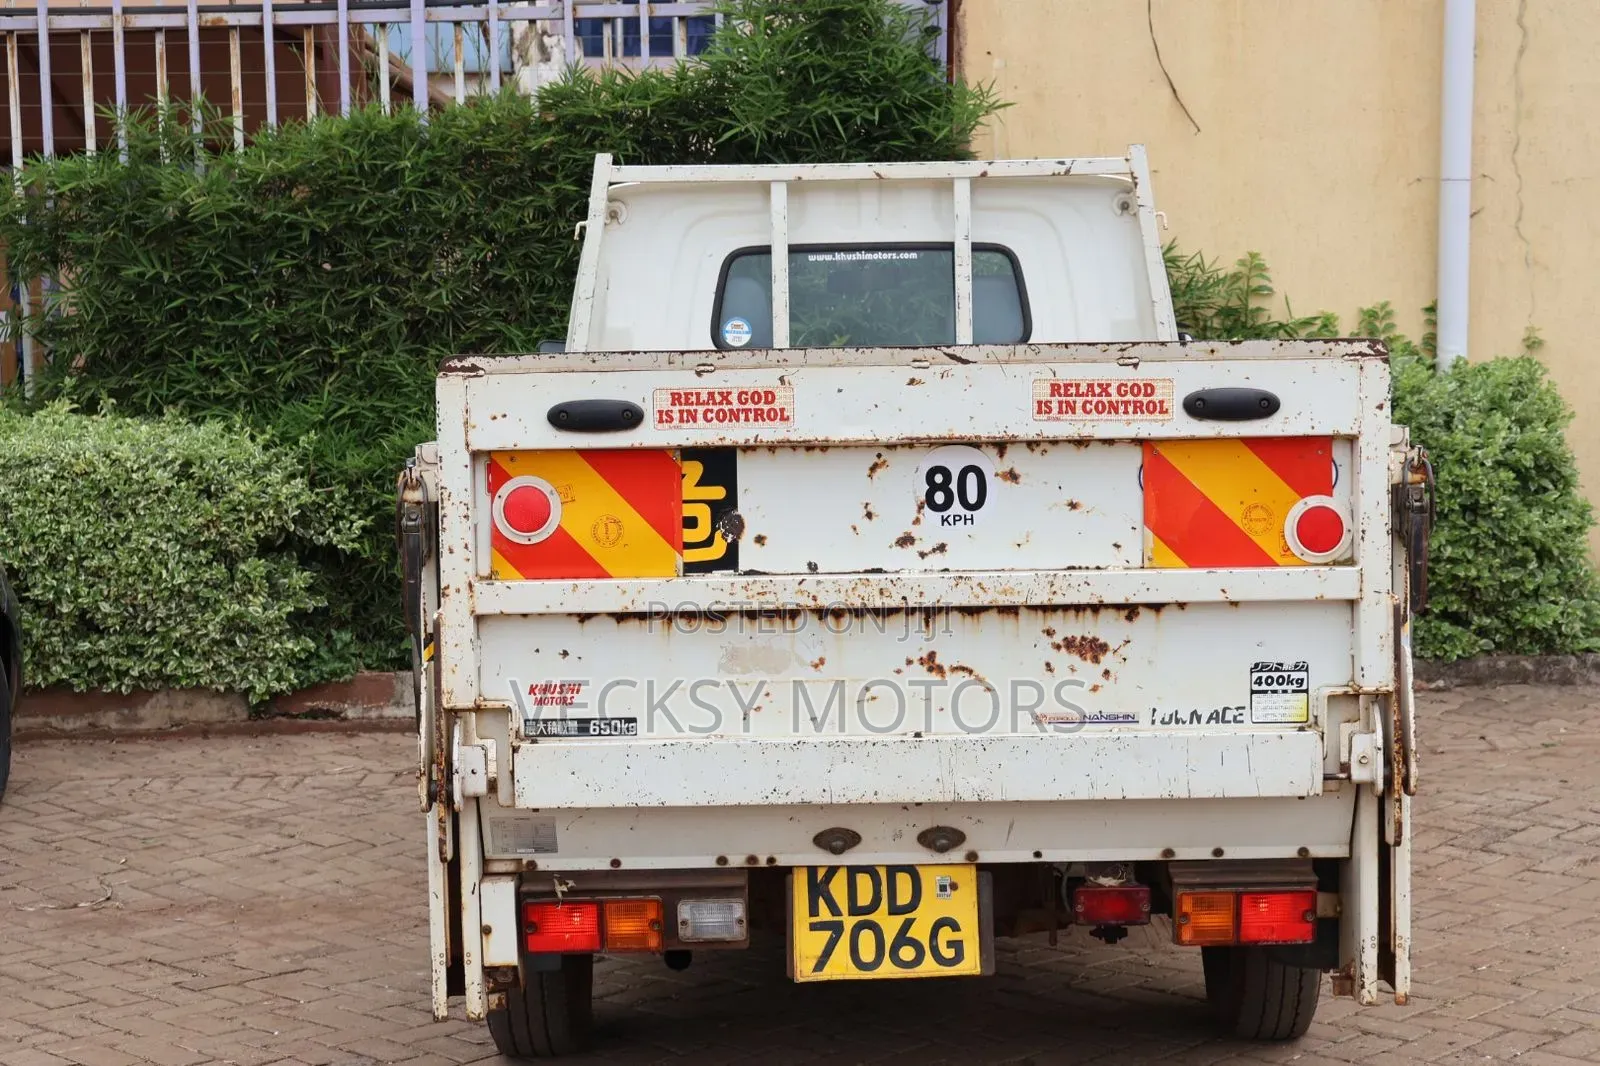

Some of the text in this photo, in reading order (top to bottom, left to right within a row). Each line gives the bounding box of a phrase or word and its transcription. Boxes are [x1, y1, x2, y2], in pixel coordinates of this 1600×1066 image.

[808, 251, 918, 261] www.khushimotors.com
[1049, 383, 1112, 397] RELAX
[1116, 383, 1155, 397] GOD
[670, 391, 733, 406] RELAX
[737, 390, 776, 405] GOD
[1036, 400, 1169, 415] IS IN CONTROL
[657, 407, 789, 424] IS IN CONTROL
[925, 464, 987, 512] 80
[941, 514, 974, 526] KPH
[1253, 674, 1305, 688] 400kg
[528, 683, 582, 696] KHUSHI
[533, 696, 575, 707] MOTORS
[1082, 713, 1135, 721] NANSHIN
[1205, 706, 1246, 725] ACE
[590, 719, 637, 735] 650kg
[806, 865, 922, 917] KDD
[808, 916, 965, 973] 706G
